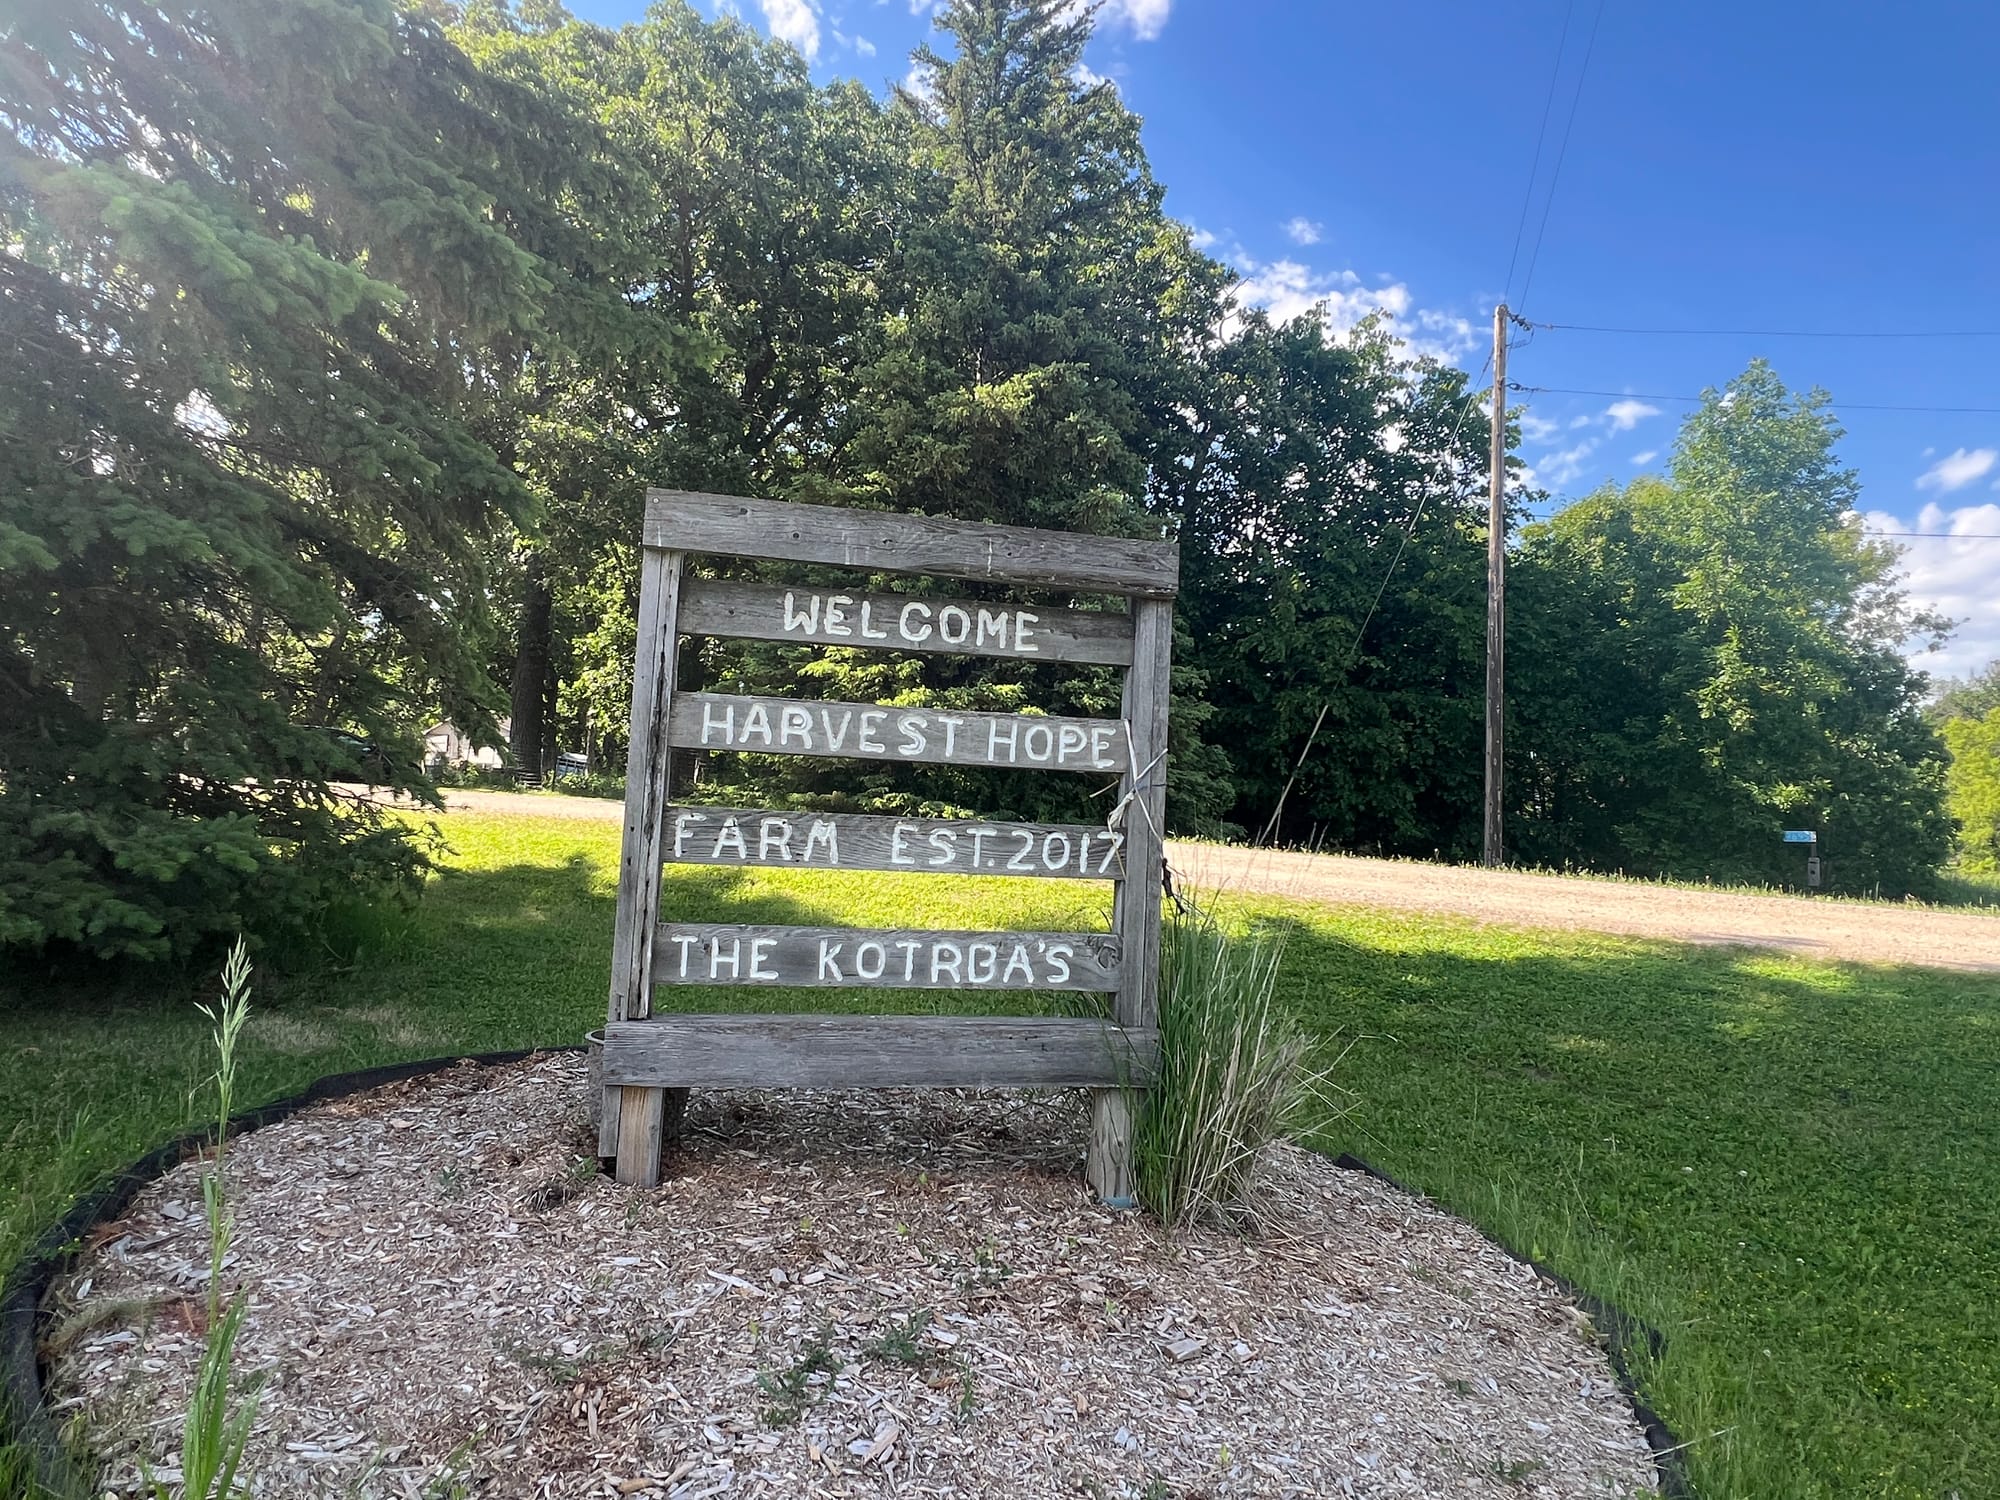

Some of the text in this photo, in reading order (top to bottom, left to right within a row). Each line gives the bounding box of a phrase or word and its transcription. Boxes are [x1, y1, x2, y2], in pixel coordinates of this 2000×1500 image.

[783, 591, 1039, 652] WELCOME
[701, 702, 1117, 768] HARVEST HOPE
[674, 813, 839, 864] FARM
[671, 935, 1074, 984] THE KOTRBA'S
